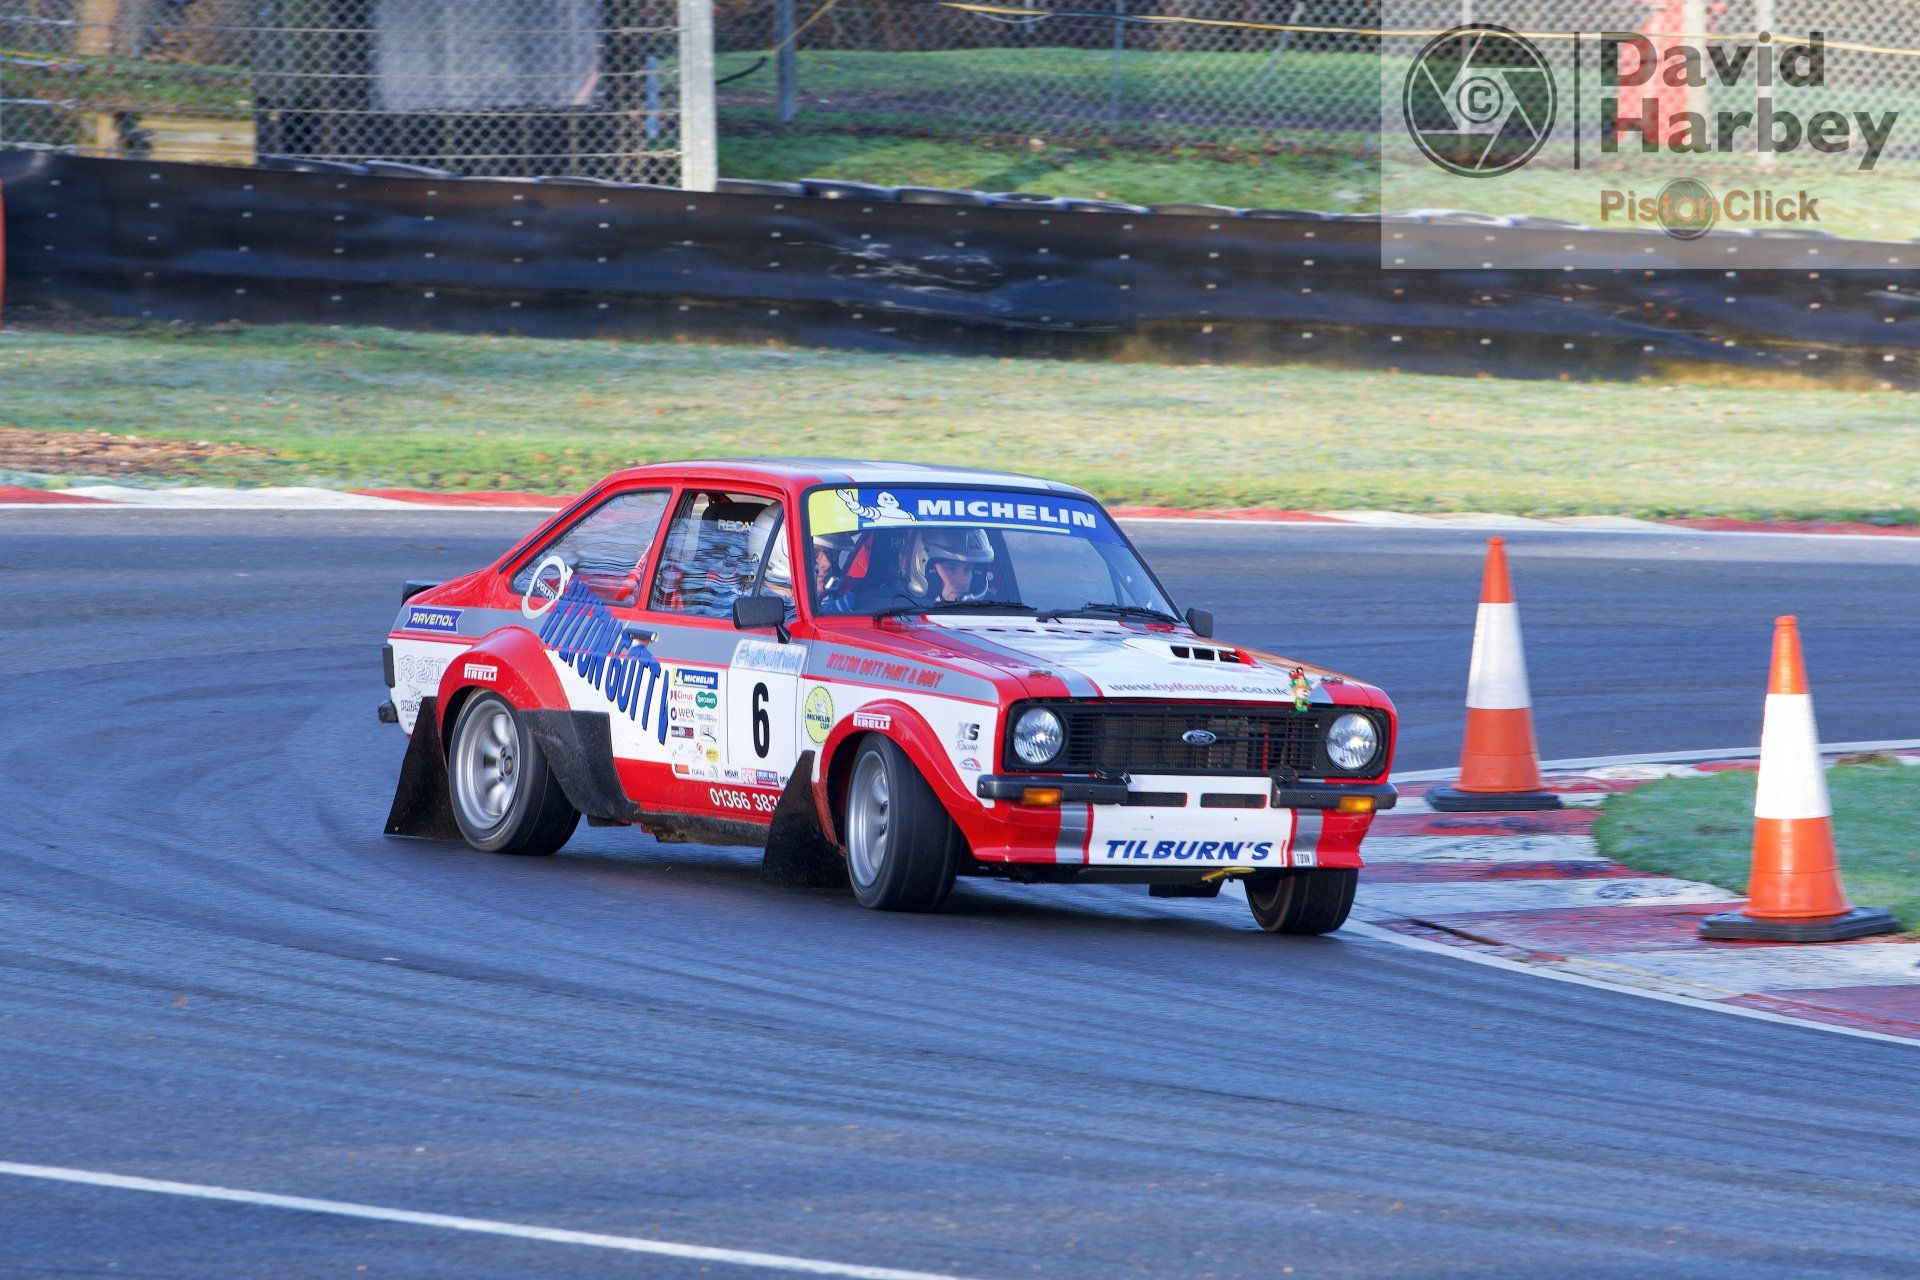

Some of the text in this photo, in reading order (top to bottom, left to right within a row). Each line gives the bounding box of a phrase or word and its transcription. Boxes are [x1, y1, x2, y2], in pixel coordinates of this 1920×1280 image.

[917, 499, 1097, 529] MICHELIN
[411, 612, 456, 627] RAVENOL
[463, 663, 498, 682] PIRELLI
[683, 673, 715, 685] MICHELIN
[752, 682, 770, 759] 6
[806, 713, 831, 723] MICHELIN
[853, 712, 891, 731] PIRELLI
[710, 788, 751, 810] 01366
[1106, 840, 1273, 860] TILBURN'S
